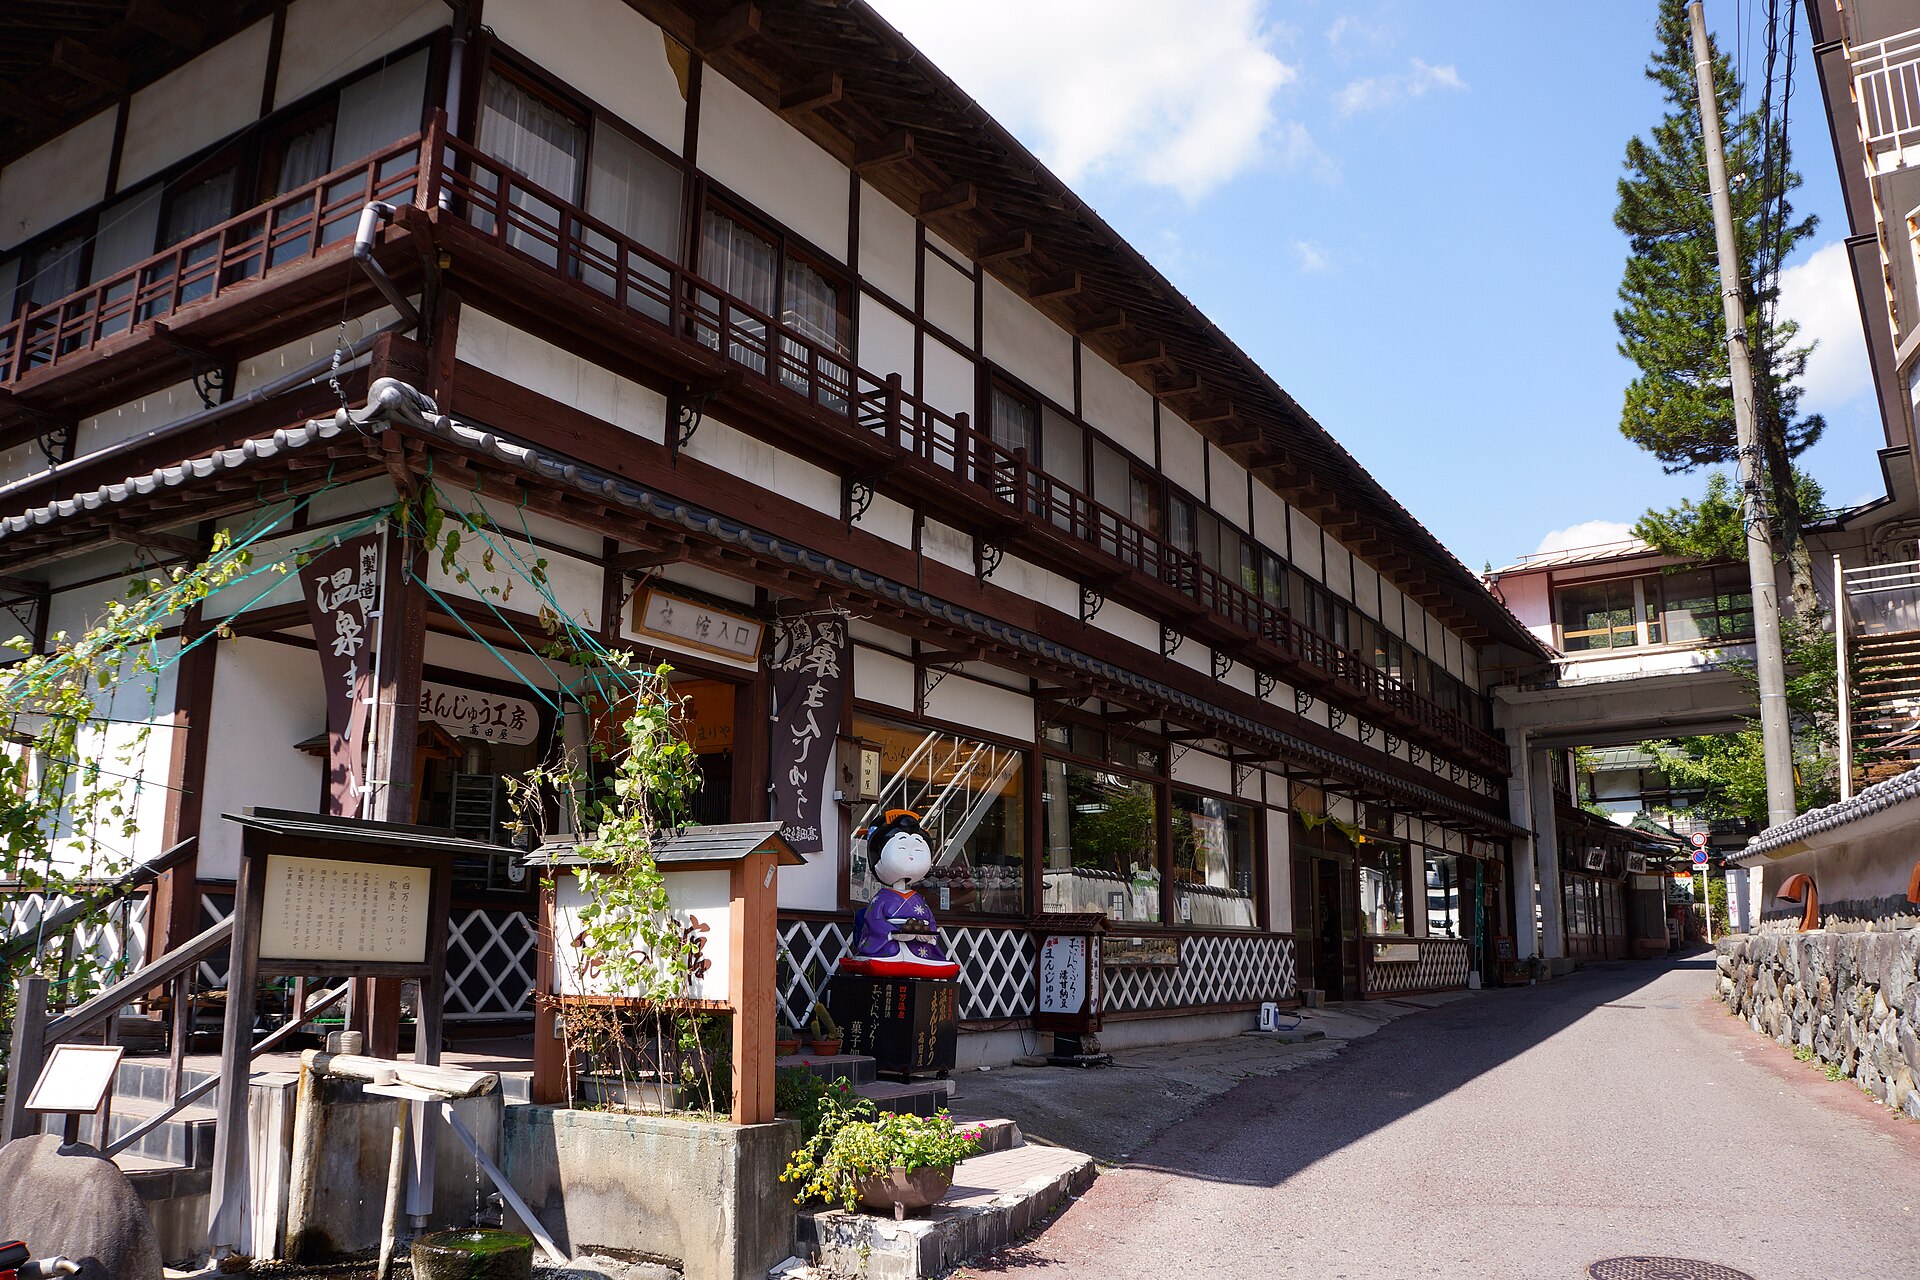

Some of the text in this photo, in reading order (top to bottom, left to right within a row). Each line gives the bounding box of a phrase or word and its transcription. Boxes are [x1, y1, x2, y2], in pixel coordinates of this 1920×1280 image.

[419, 688, 528, 731] まんじゅう工房
[1044, 949, 1055, 1008] まんじゅう
[898, 986, 907, 1019] 四万温泉
